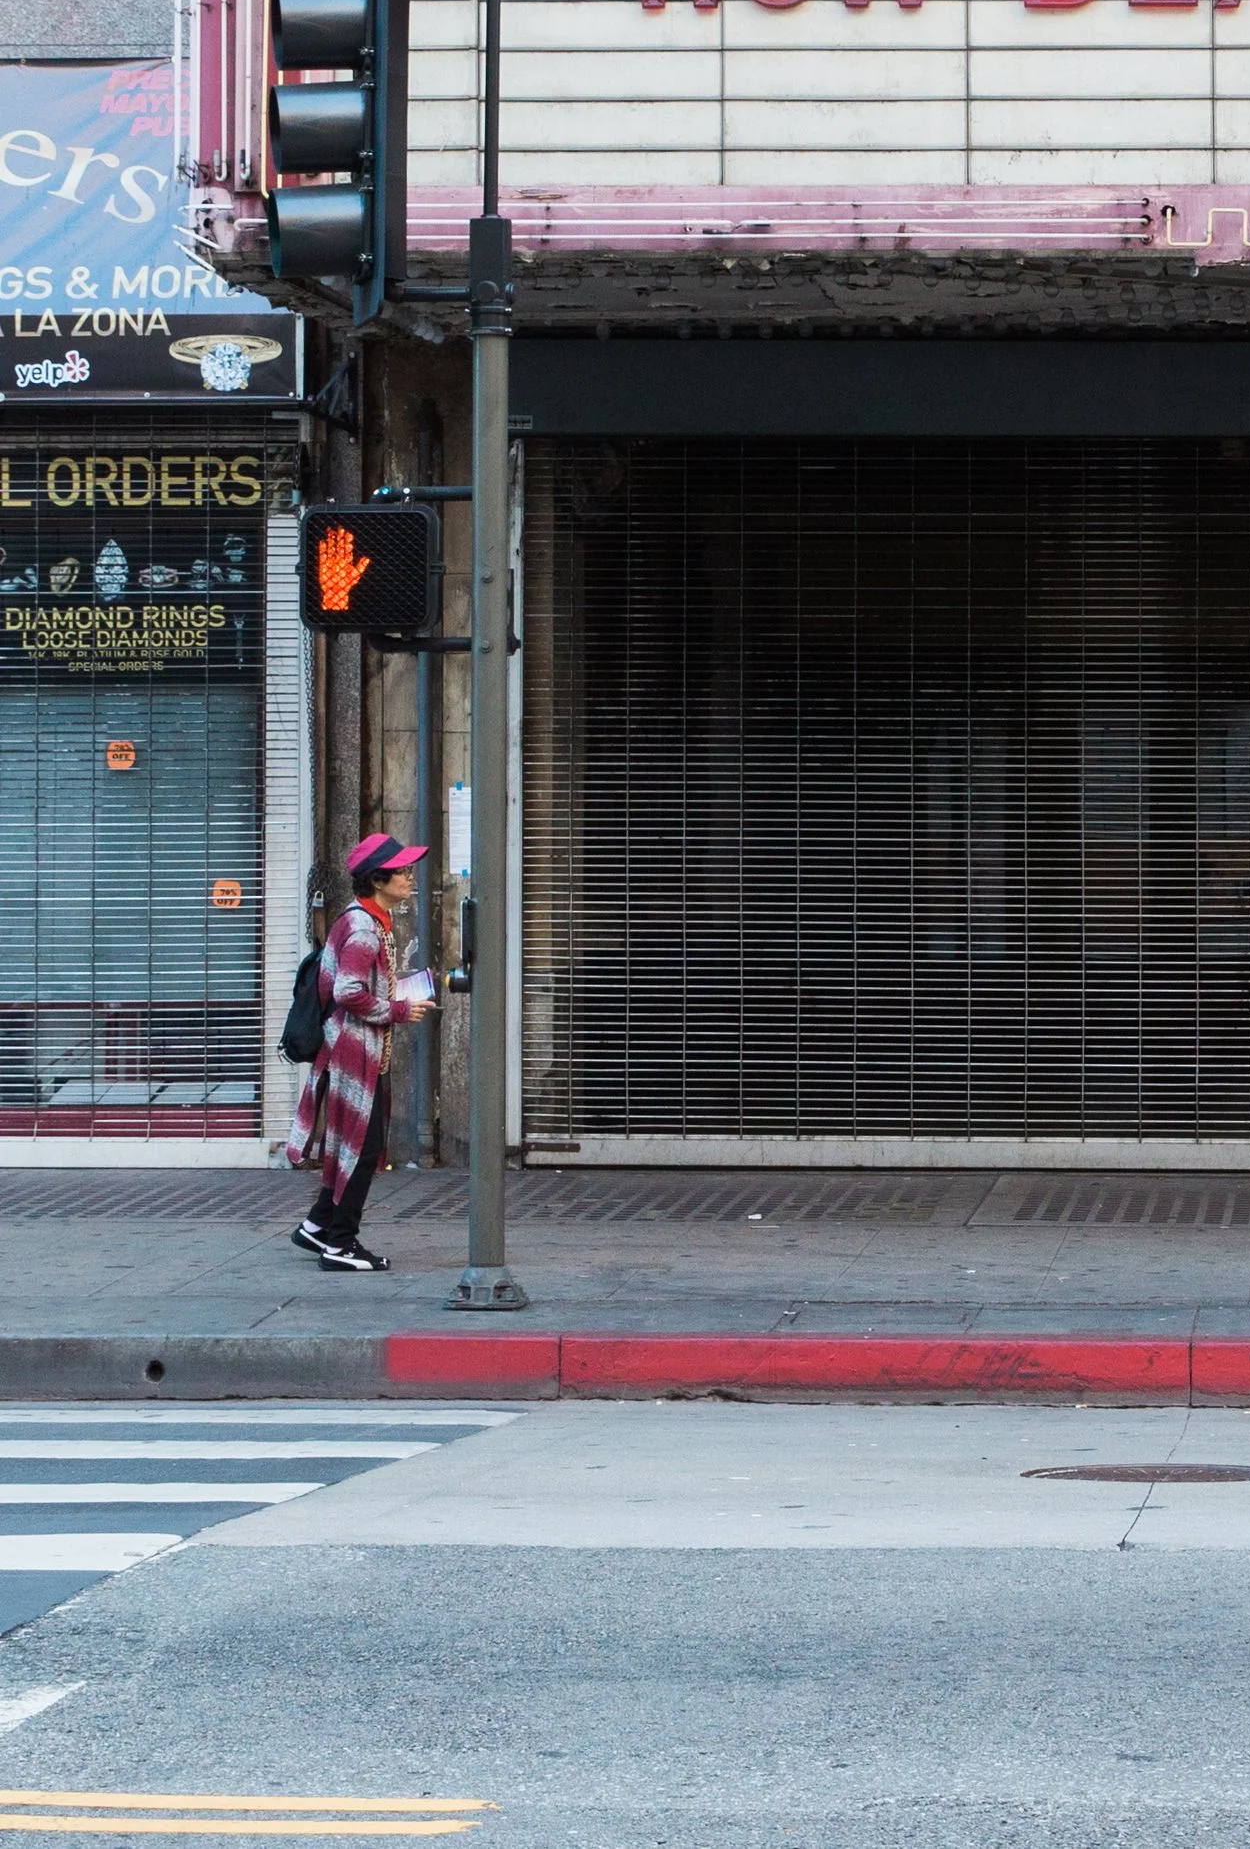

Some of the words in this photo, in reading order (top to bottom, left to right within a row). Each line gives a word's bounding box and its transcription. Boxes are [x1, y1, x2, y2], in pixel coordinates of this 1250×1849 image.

[65, 266, 99, 299] &
[15, 308, 62, 337] LA
[71, 307, 171, 337] ZONA
[16, 360, 68, 387] yelp
[47, 456, 262, 507] ORDERS
[5, 606, 134, 630] DIAMOND
[143, 605, 226, 628] RINGS
[22, 631, 91, 648] LOOSE
[96, 630, 208, 647] DIAMONDS
[68, 661, 116, 672] SPECIAL
[118, 661, 164, 672] ORDERS
